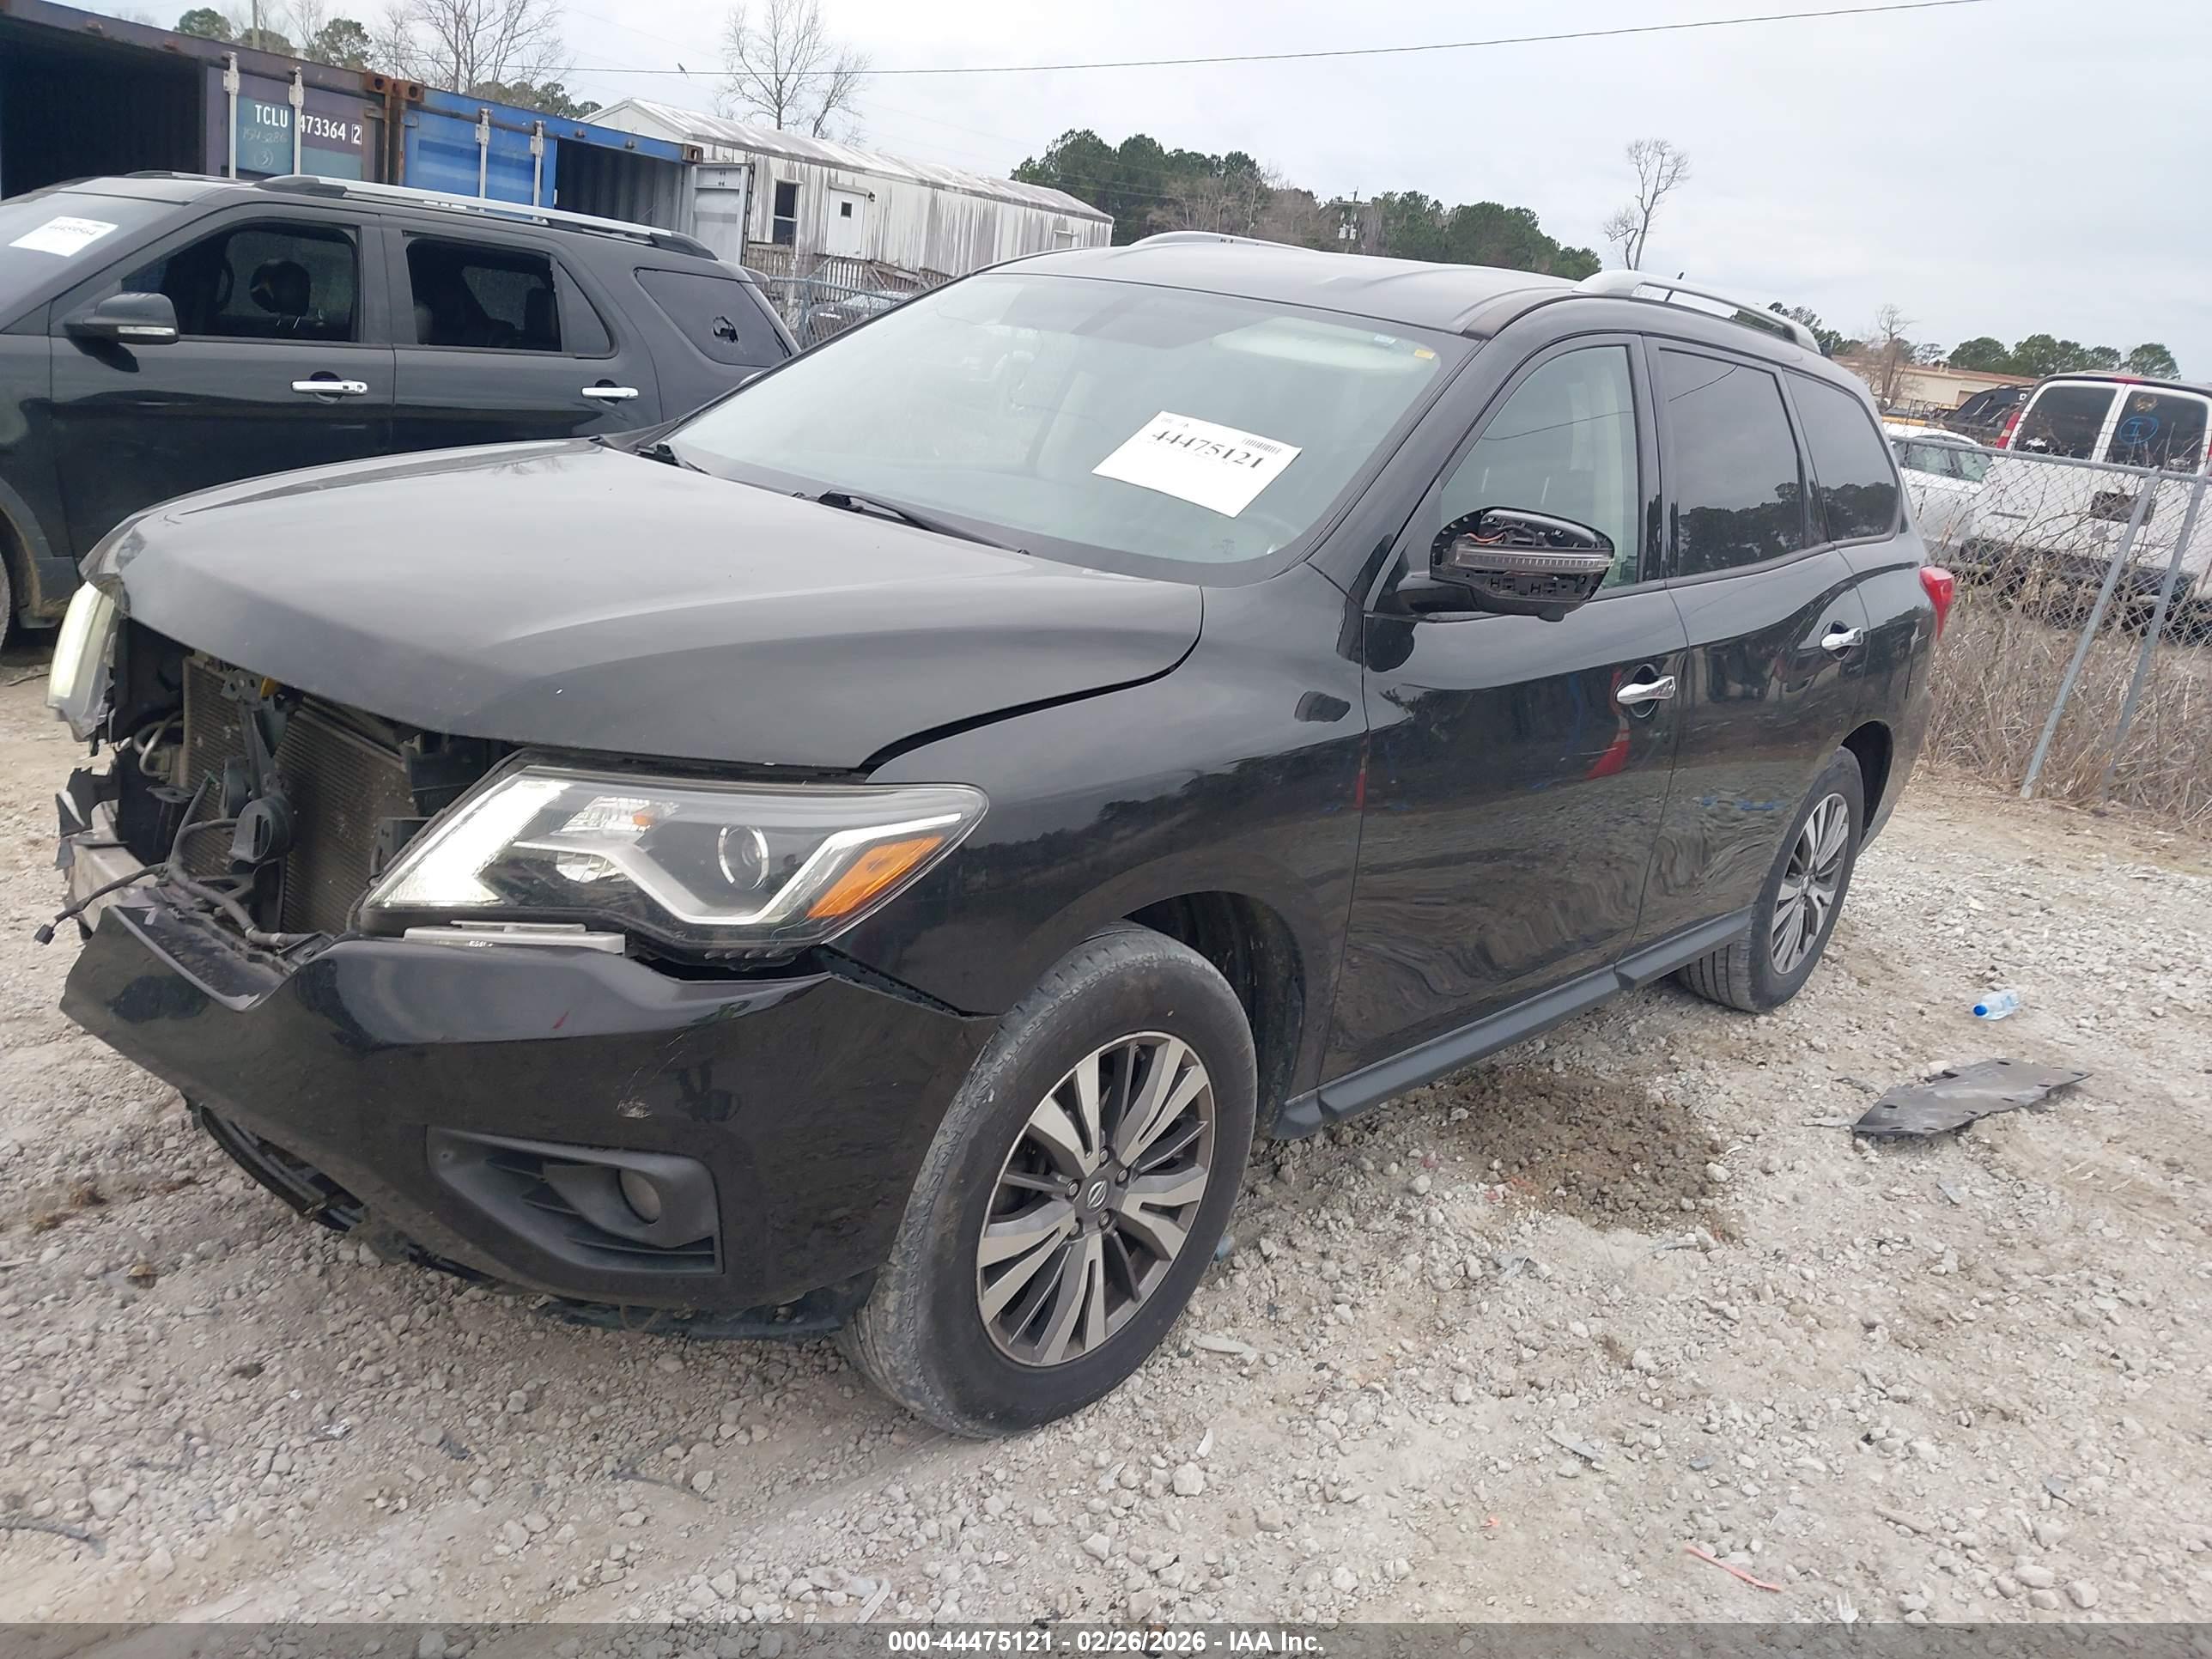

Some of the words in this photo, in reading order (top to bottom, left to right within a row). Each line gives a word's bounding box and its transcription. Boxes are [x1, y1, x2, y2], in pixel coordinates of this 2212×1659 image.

[254, 104, 289, 128] TCLU
[353, 125, 361, 144] 2
[1152, 430, 1264, 469] 44475121
